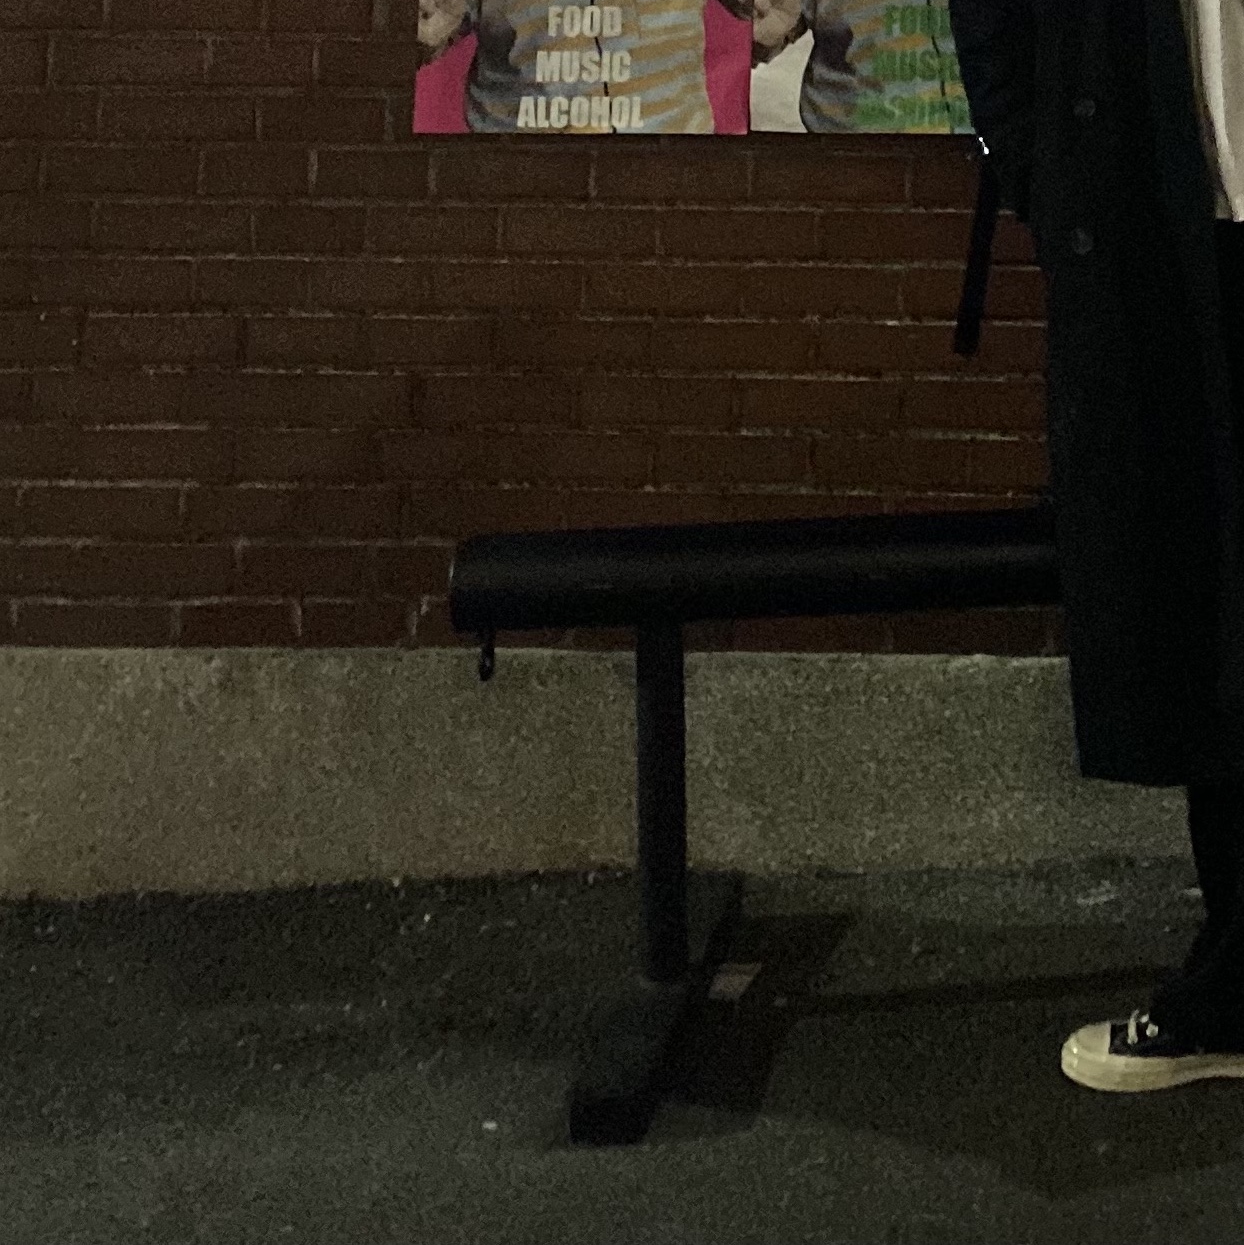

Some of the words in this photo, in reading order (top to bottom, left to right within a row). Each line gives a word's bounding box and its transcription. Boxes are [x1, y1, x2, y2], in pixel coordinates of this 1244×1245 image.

[548, 6, 621, 37] FOOD
[536, 51, 630, 82] MUSIC
[517, 96, 643, 129] ALCOHOL
